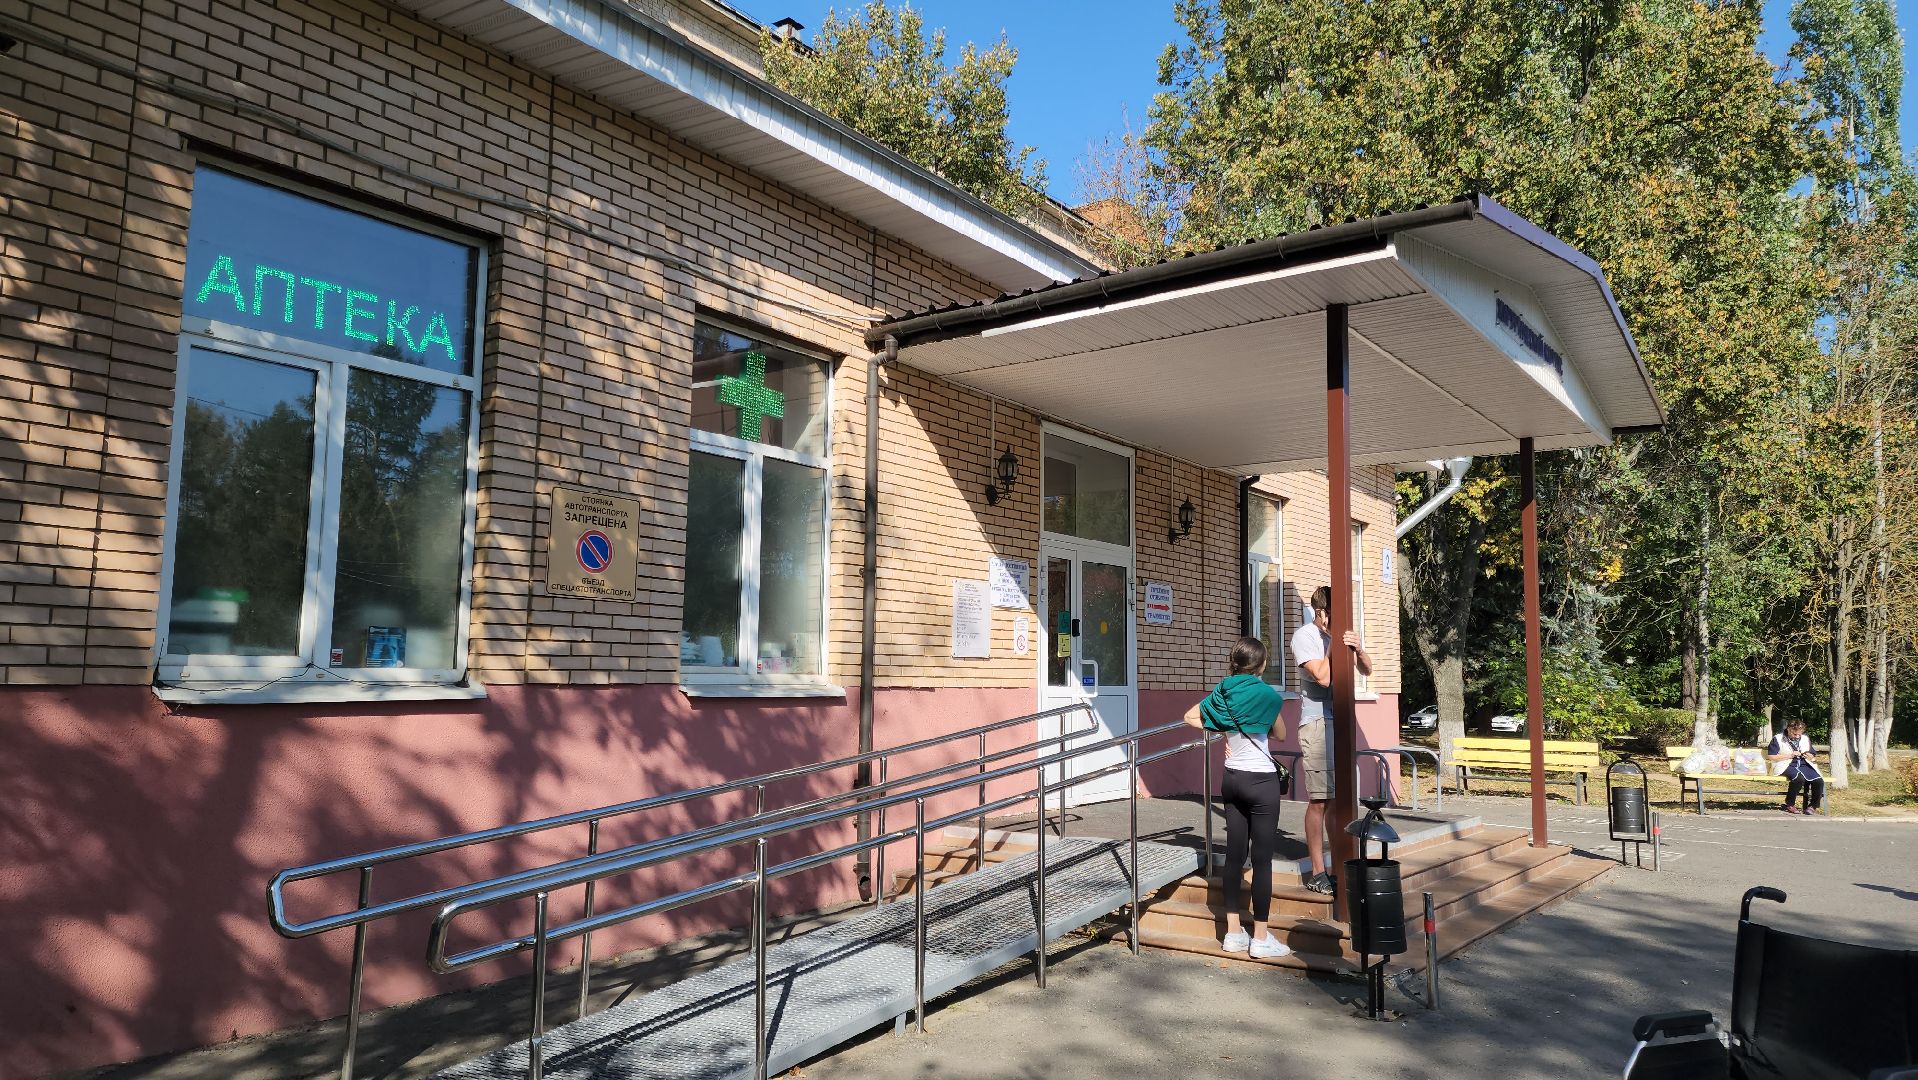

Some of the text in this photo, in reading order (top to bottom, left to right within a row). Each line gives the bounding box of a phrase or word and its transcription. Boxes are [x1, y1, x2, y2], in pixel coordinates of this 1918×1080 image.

[196, 255, 457, 361] АПТЕКА
[581, 495, 614, 507] СТОЯНКА
[564, 502, 628, 518] АВТОТРАНСПОРТА
[564, 511, 627, 529] ЗАПРЕЩЕНА
[581, 577, 605, 587] ВЪЕЗД
[551, 583, 632, 598] СПЕЦАВТОТРАНСПОРТА
